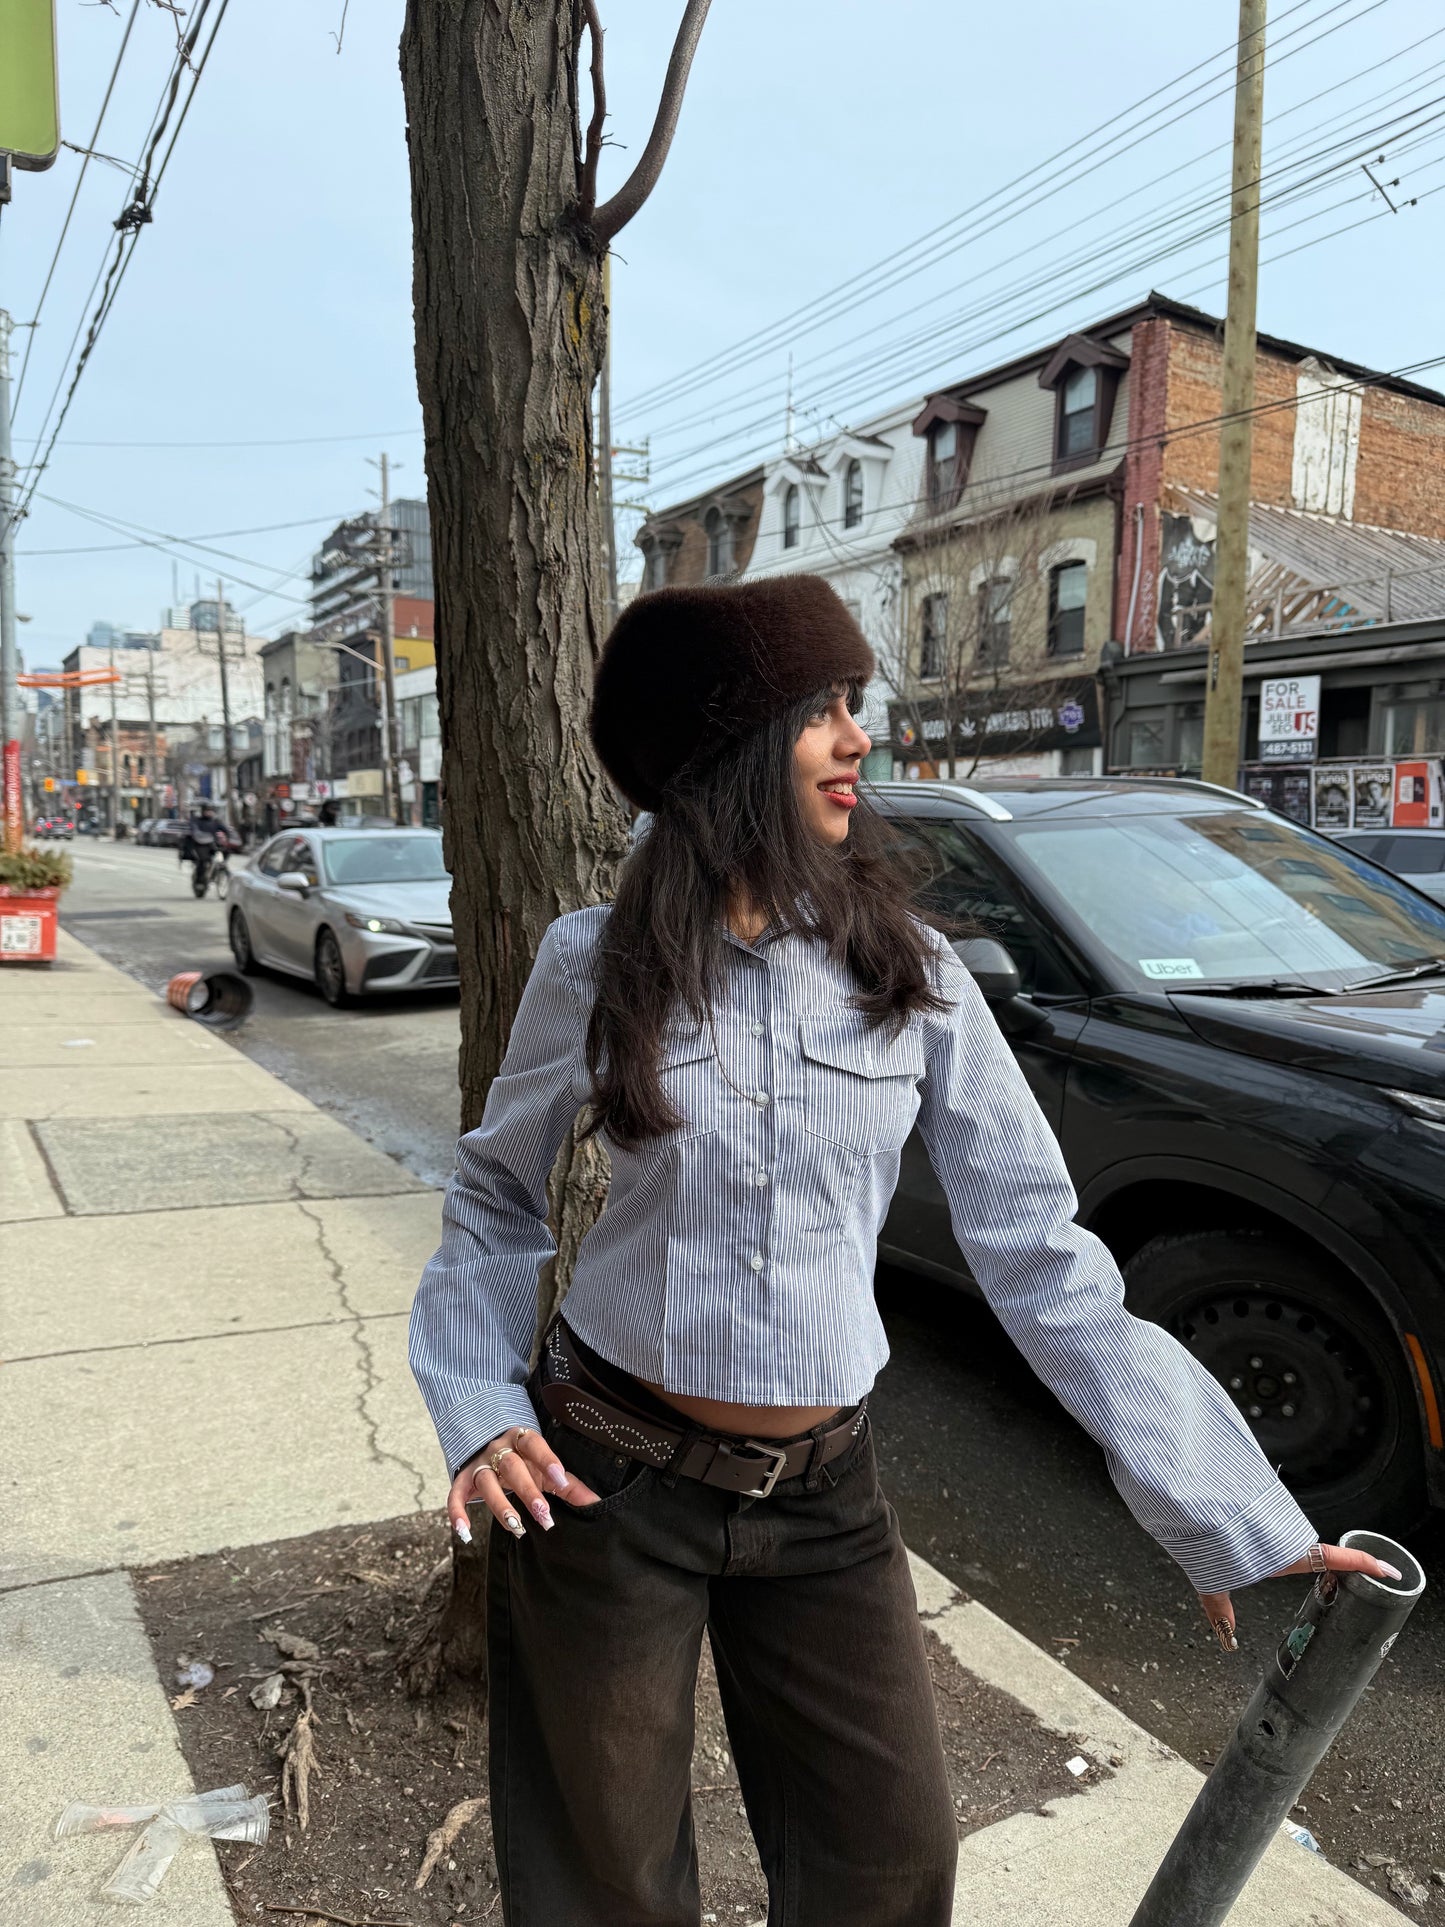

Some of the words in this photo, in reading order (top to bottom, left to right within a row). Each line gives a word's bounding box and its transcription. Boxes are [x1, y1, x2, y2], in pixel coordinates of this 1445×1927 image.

[1265, 682, 1300, 697] FOR
[1264, 695, 1307, 712] SALE
[1146, 963, 1194, 976] Uber
